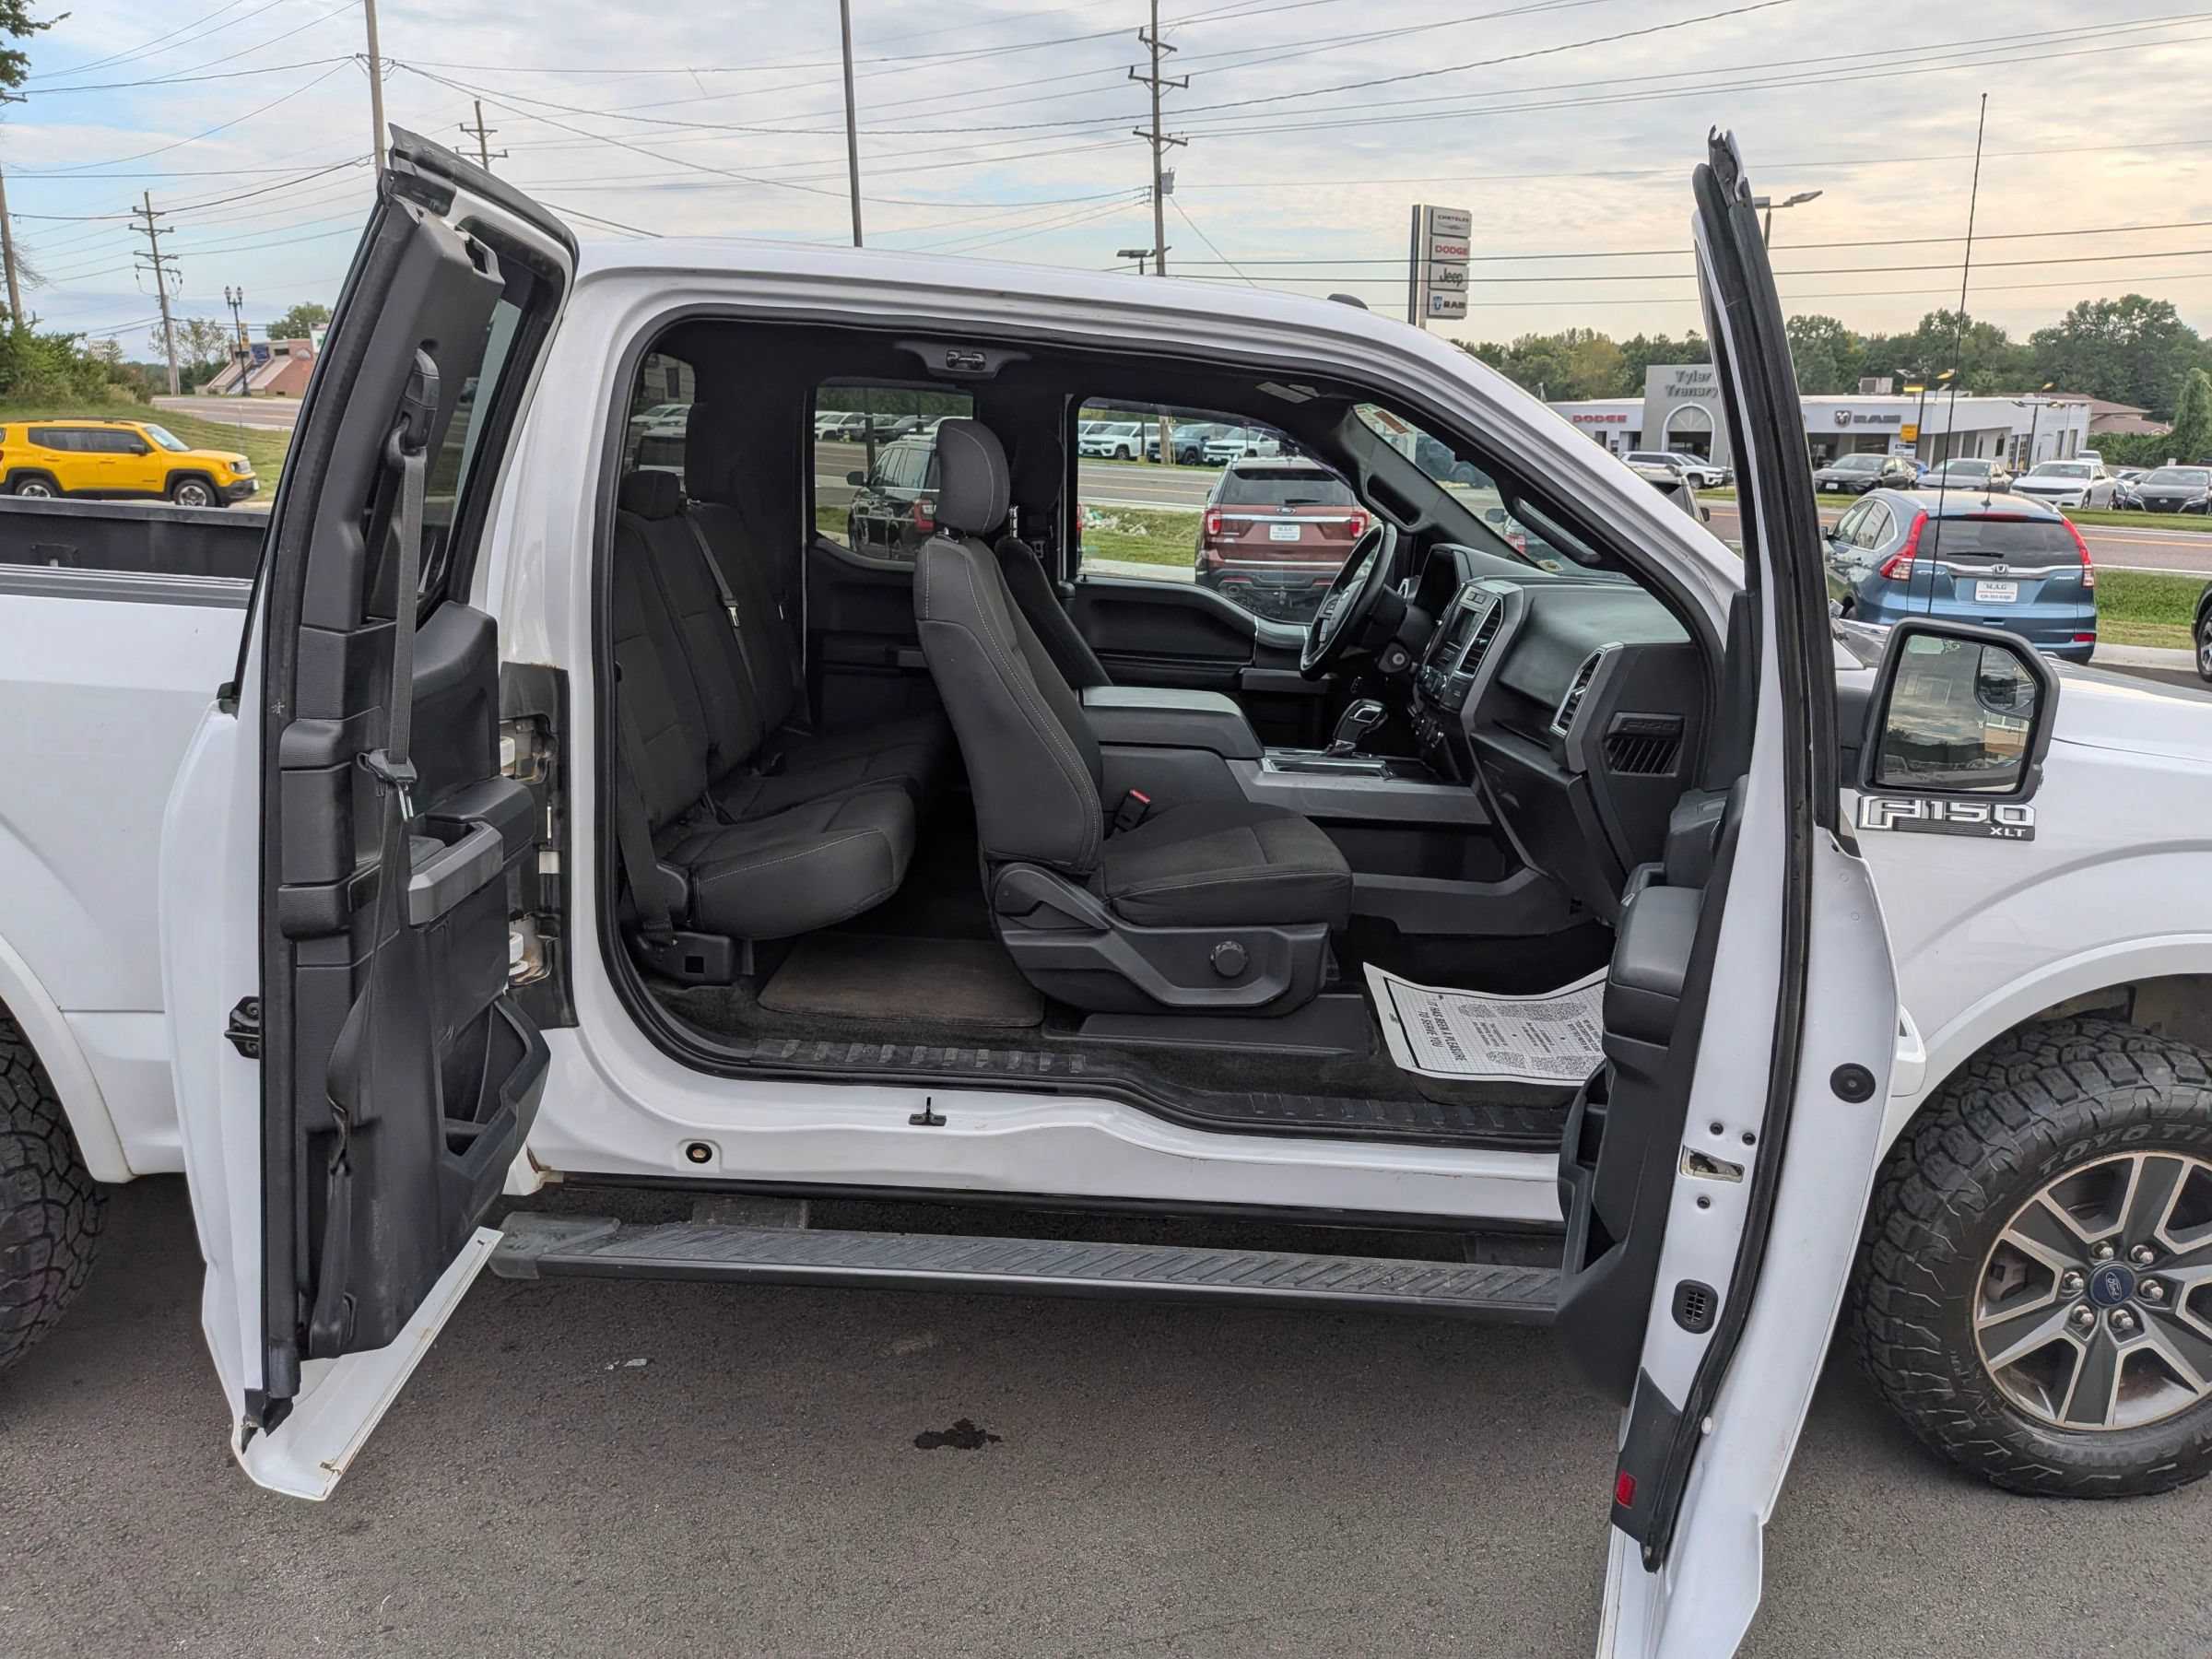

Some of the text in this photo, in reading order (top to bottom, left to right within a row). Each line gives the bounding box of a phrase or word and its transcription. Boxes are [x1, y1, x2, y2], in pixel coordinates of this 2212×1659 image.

[1438, 215, 1469, 223] CHRYSLER
[1435, 245, 1468, 255] DODGE
[1440, 267, 1463, 287] Jeep
[1443, 300, 1466, 309] RAM
[1676, 371, 1712, 384] Tyler
[1572, 415, 1628, 423] DODGE
[1853, 415, 1901, 423] RAM
[1990, 827, 2027, 837] XLT
[1430, 1006, 1443, 1018] HAS
[1434, 1018, 1451, 1031] BEEN
[1420, 1018, 1438, 1036] SERVE
[1430, 1036, 1444, 1047] YOU
[1443, 1035, 1467, 1062] PLEASURE
[2040, 1124, 2153, 1175] TOYO
